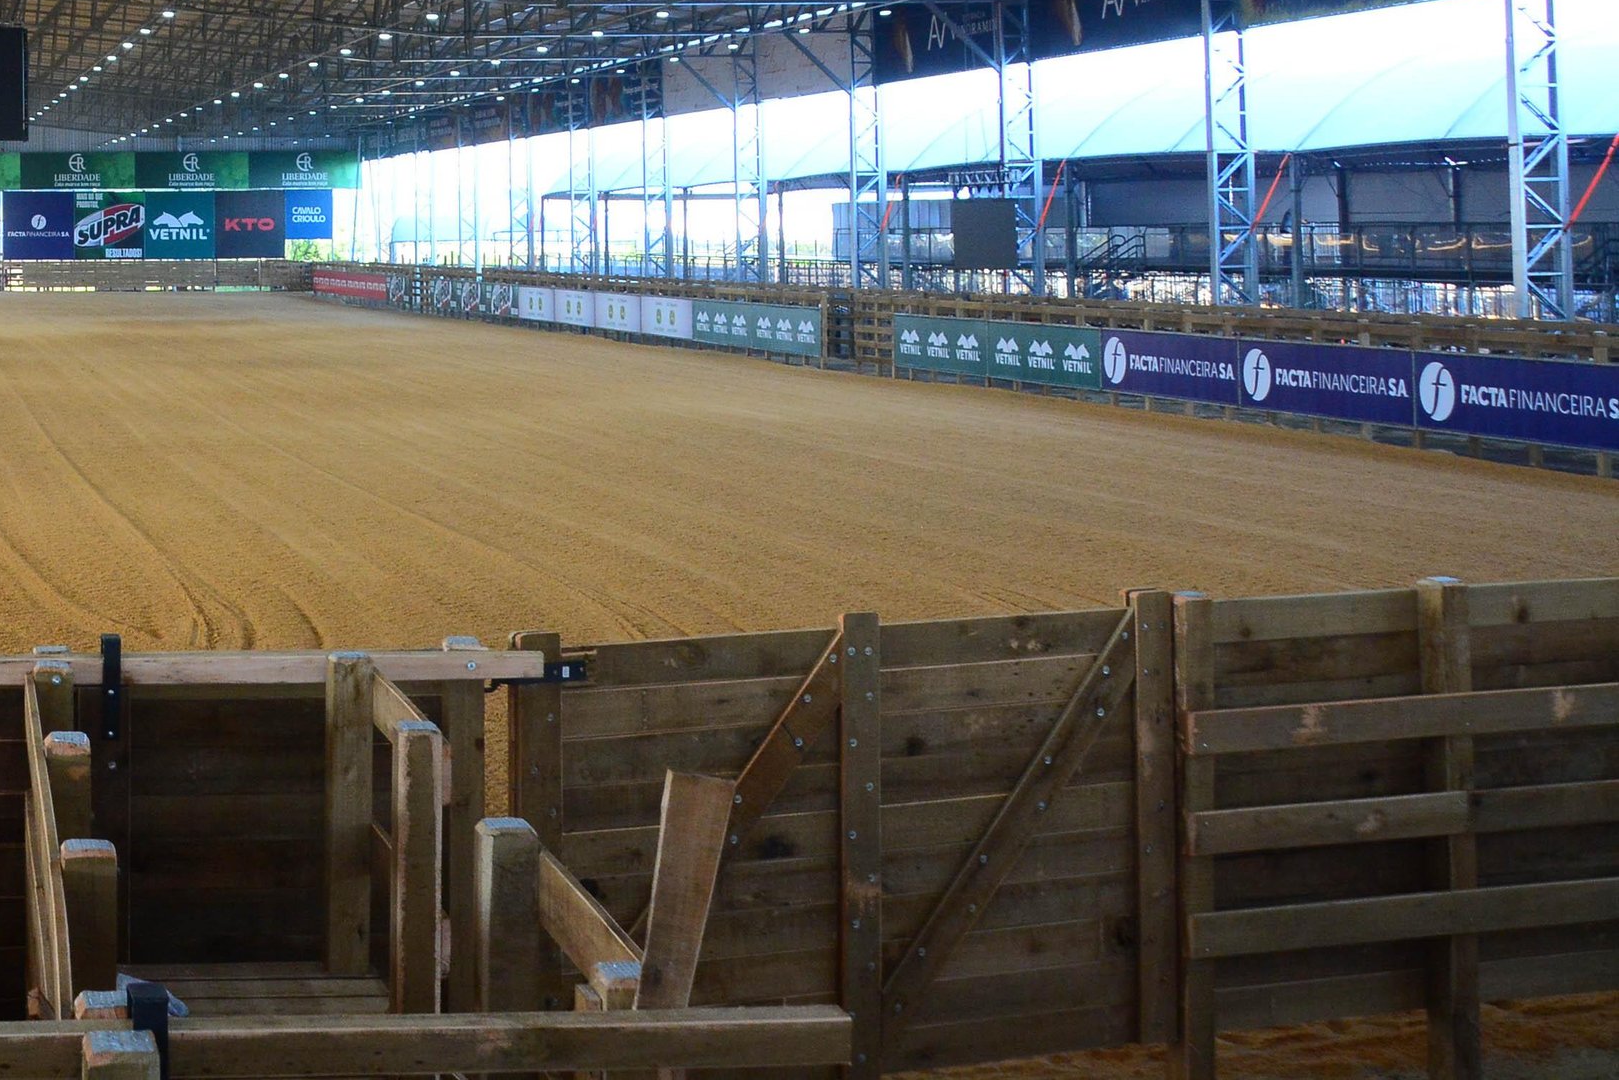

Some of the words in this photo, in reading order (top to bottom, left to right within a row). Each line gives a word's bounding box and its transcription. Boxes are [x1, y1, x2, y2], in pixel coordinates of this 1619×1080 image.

[951, 19, 998, 41] VNDRAMIN
[54, 173, 100, 182] LIBERDADE
[168, 173, 215, 181] LIBERDADE
[282, 172, 328, 181] LIBERDADE
[292, 207, 321, 215] CAVALO
[77, 206, 141, 246] SUPRA
[225, 217, 275, 232] KTO
[292, 215, 326, 223] CRIOULO
[149, 228, 208, 240] VETNIL
[900, 343, 921, 356] VETNIL
[927, 346, 950, 359] VETNIL
[956, 348, 980, 362] VETNIL
[995, 353, 1021, 366] VETNIL
[1027, 356, 1055, 370] VETNIL
[1062, 359, 1092, 374] VETNIL
[1129, 354, 1159, 372] FACTA
[1159, 357, 1219, 379] FINANCEIRA
[1219, 362, 1236, 380] SA
[1275, 368, 1312, 388] FACTA
[1312, 371, 1387, 396] FINANCEIRA
[1388, 377, 1409, 398] SA
[1461, 384, 1508, 408] FACTA
[1509, 389, 1608, 418] FINANCEIRA
